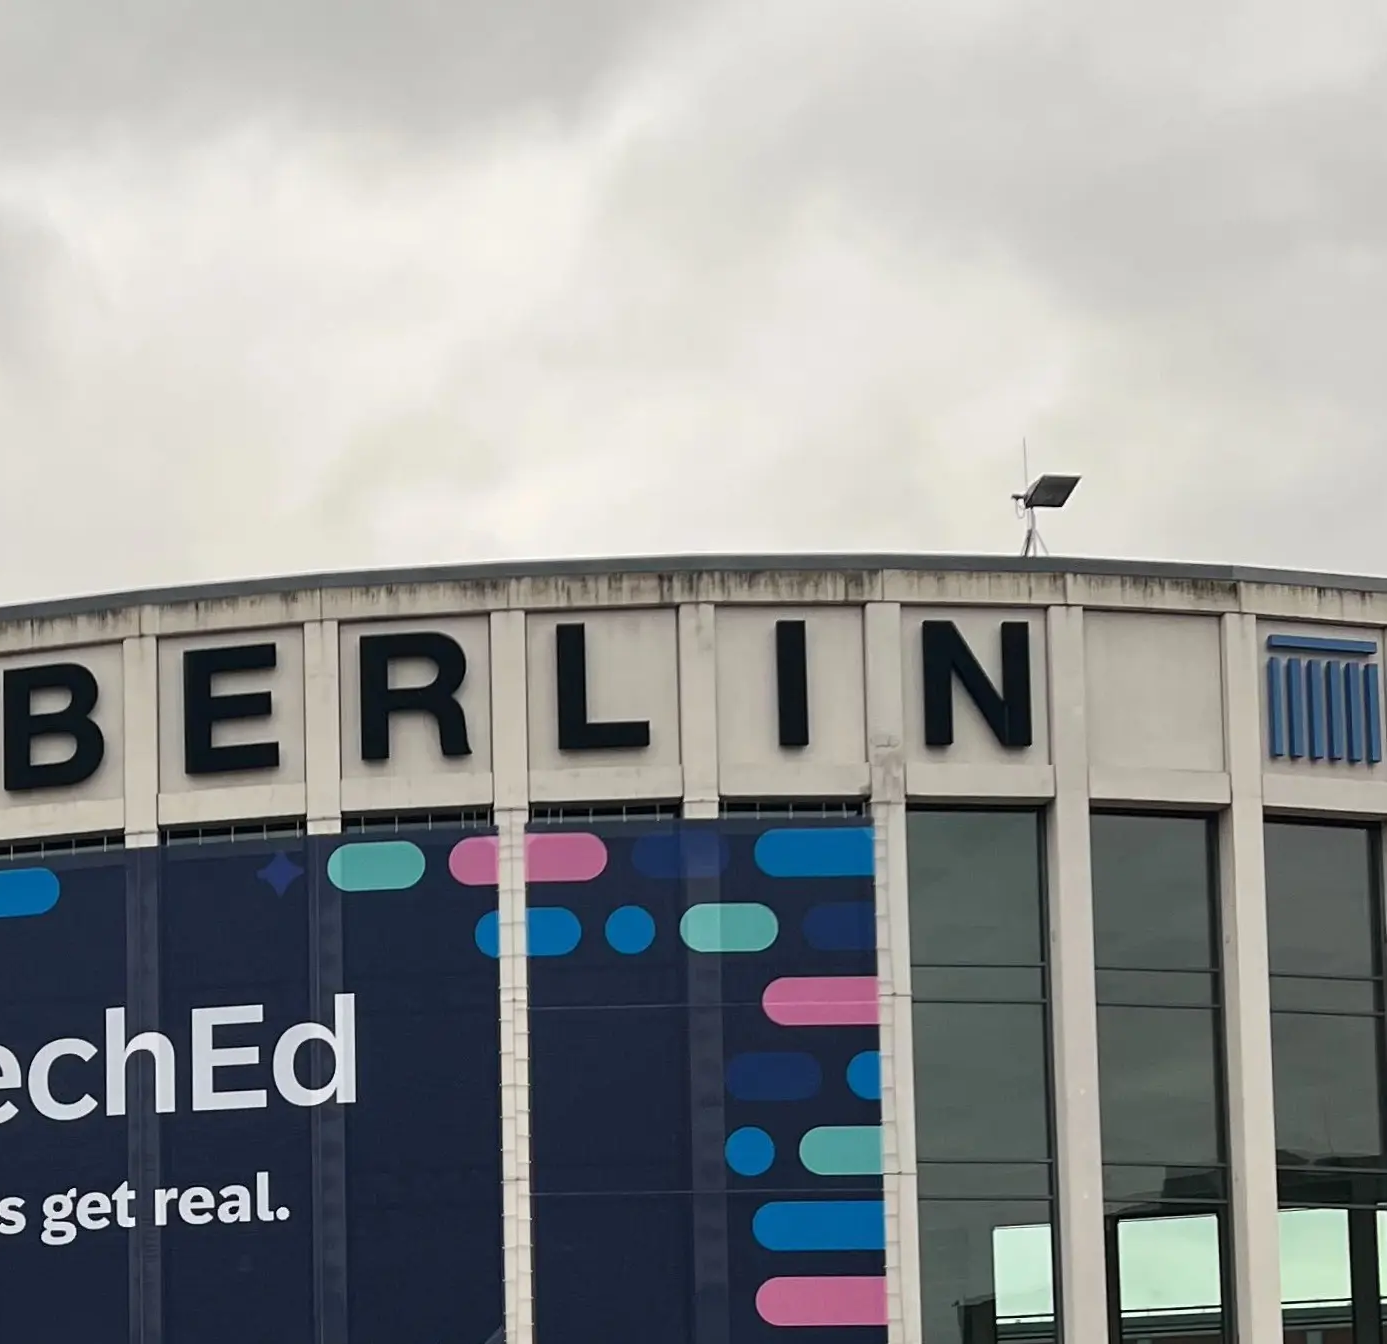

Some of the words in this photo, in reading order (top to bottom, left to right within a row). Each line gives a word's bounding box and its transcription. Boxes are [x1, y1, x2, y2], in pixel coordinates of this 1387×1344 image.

[3, 620, 1032, 792] BERLIN
[40, 1178, 136, 1245] get
[154, 1172, 290, 1226] real.
